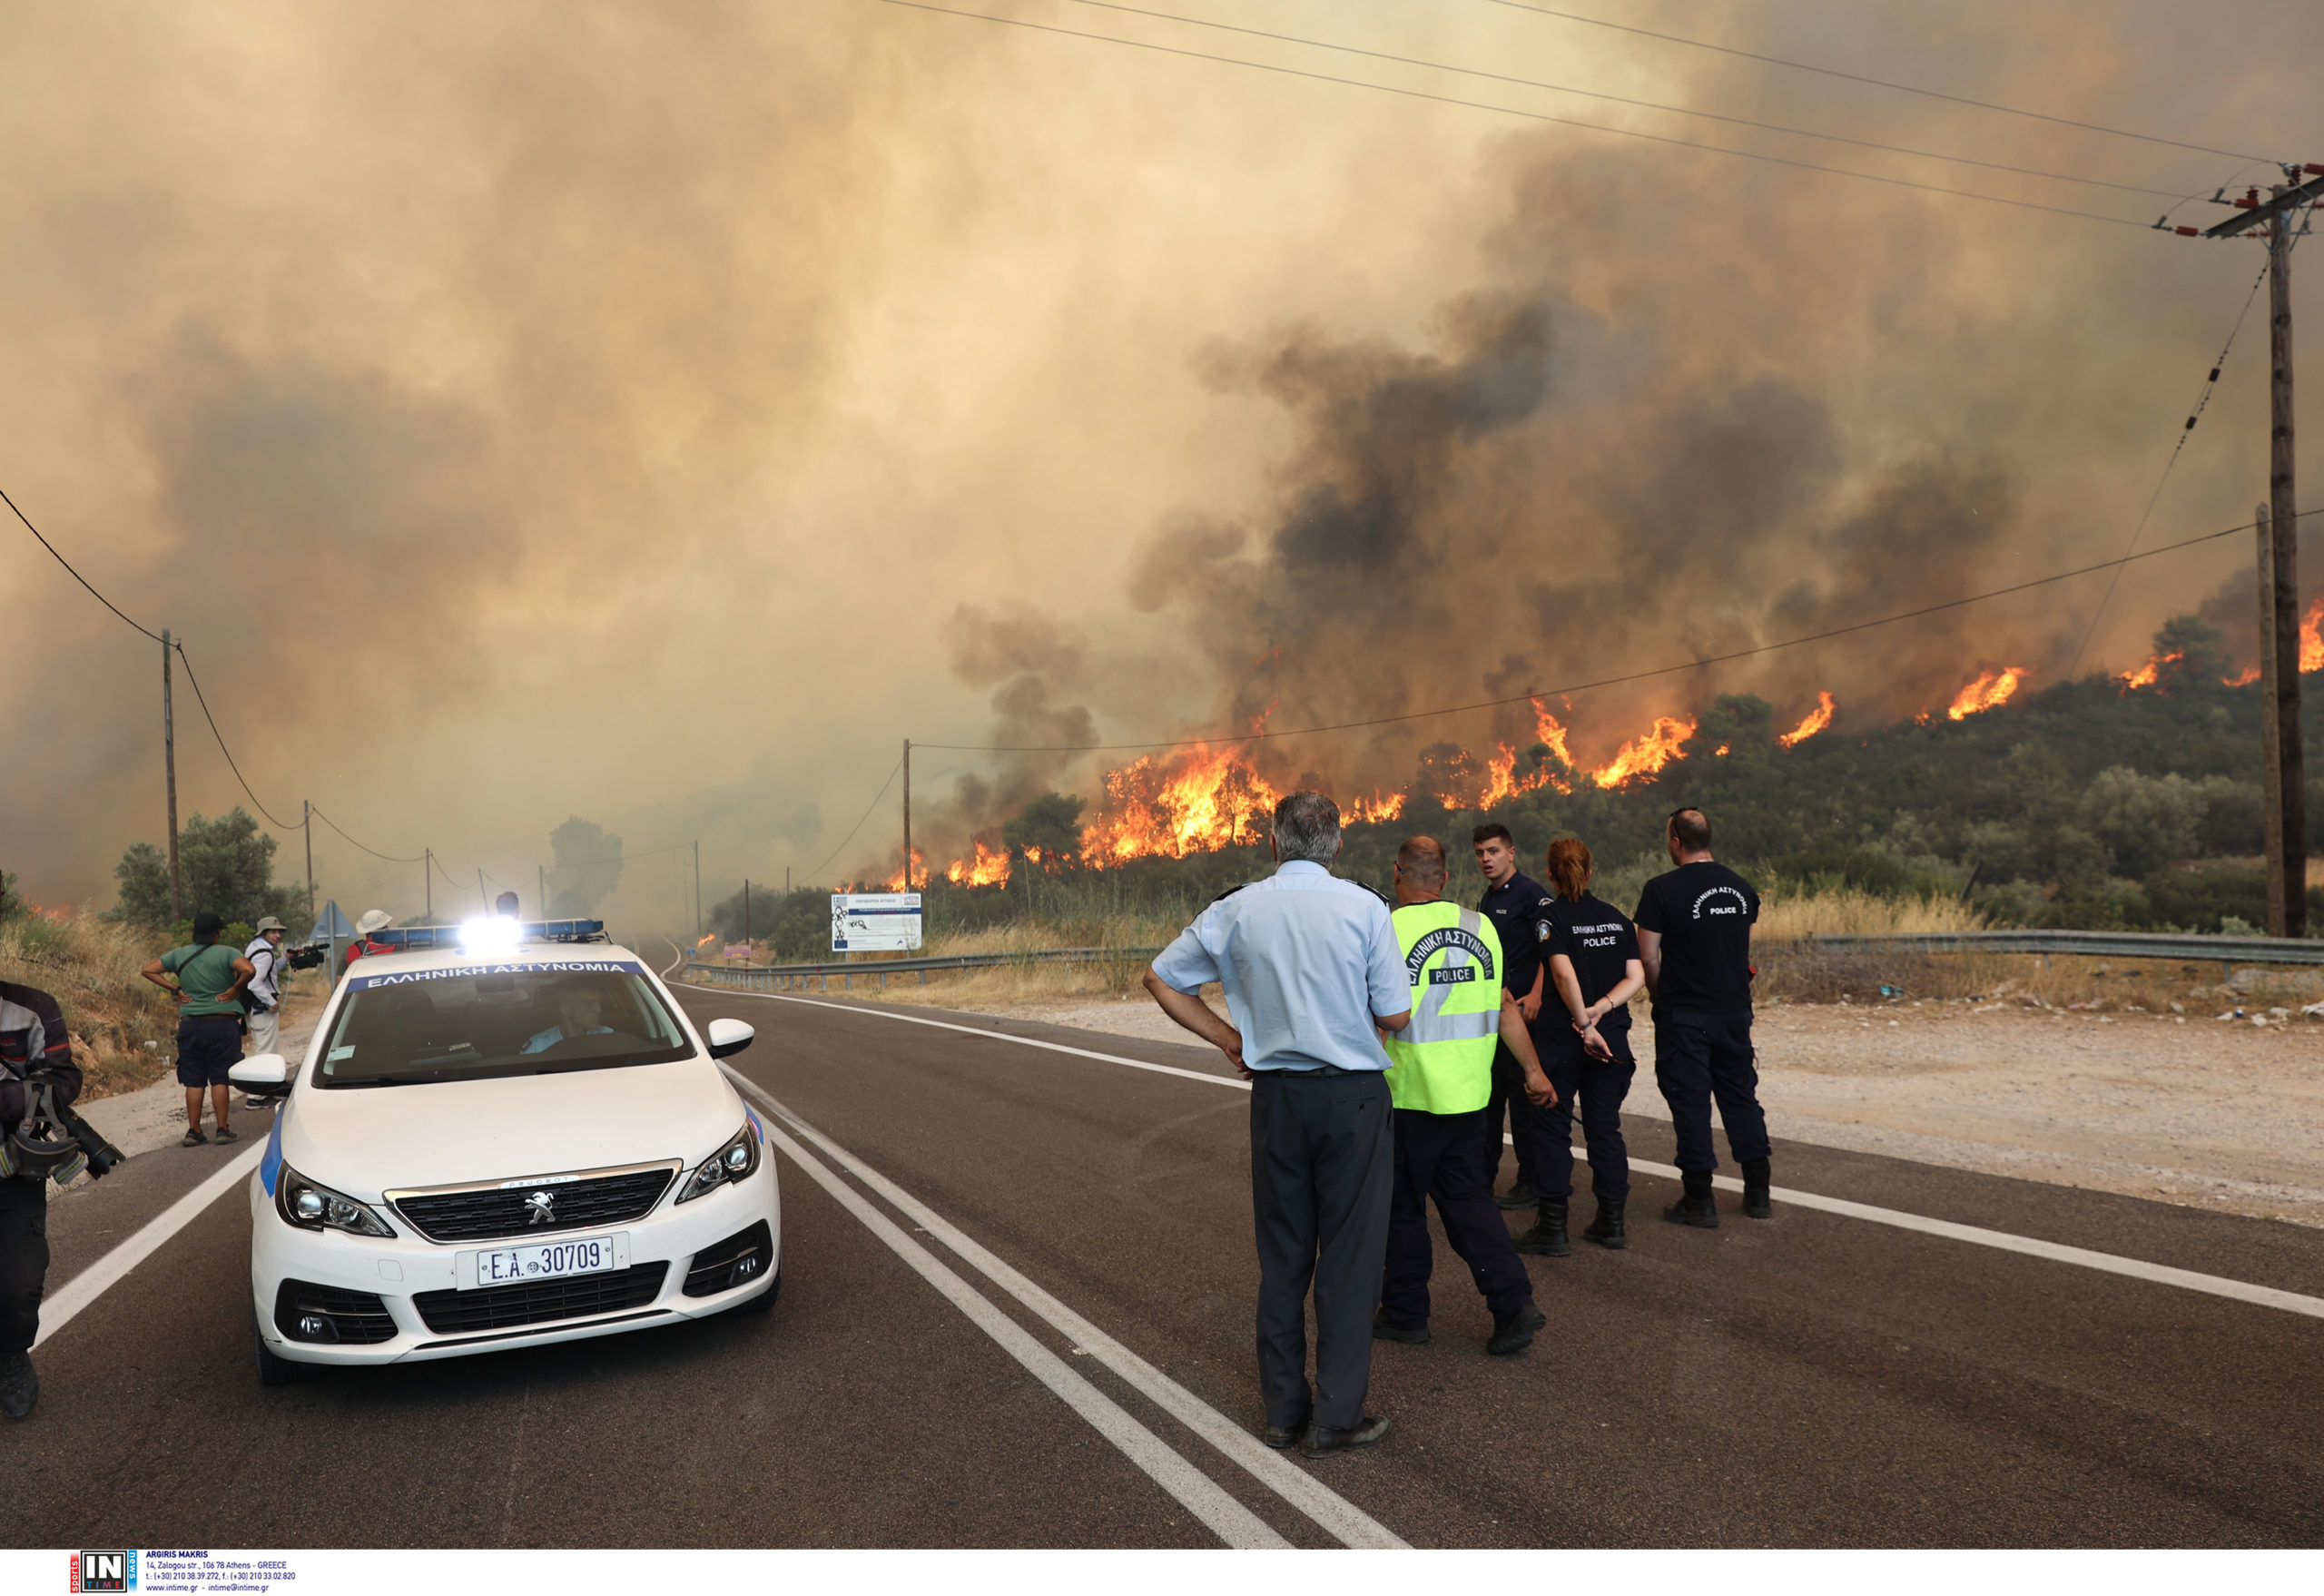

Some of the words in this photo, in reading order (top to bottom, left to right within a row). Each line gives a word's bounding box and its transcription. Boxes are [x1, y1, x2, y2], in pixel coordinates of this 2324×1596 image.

[1709, 906, 1737, 915] POLICE
[1583, 936, 1617, 948] POLICE
[1445, 931, 1492, 979] ΑΣΤΥΝΟΜΙΑ
[367, 965, 487, 989] ΕΛΛΗΝΙΚΗ
[494, 962, 625, 974] ΑΣΤΥΝΟΜΙΑ
[1435, 968, 1471, 982] POLICE
[508, 1177, 569, 1189] PEUGEOT
[541, 1242, 600, 1273] 30709
